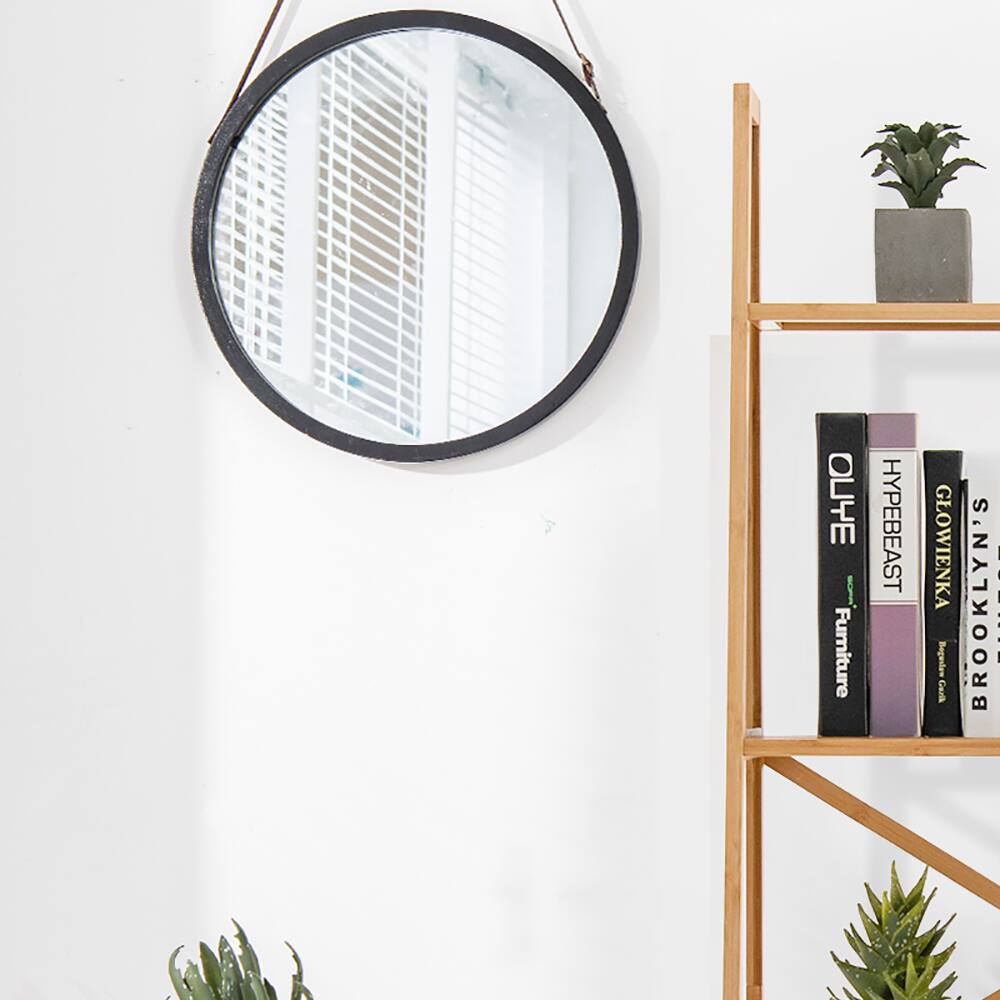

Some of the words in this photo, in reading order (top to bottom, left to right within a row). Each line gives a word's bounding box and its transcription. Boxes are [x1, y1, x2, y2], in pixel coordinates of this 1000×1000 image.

[882, 459, 902, 593] HYPEBEAST
[834, 607, 853, 698] Furniture
[972, 497, 989, 711] BROOKLYN'S
